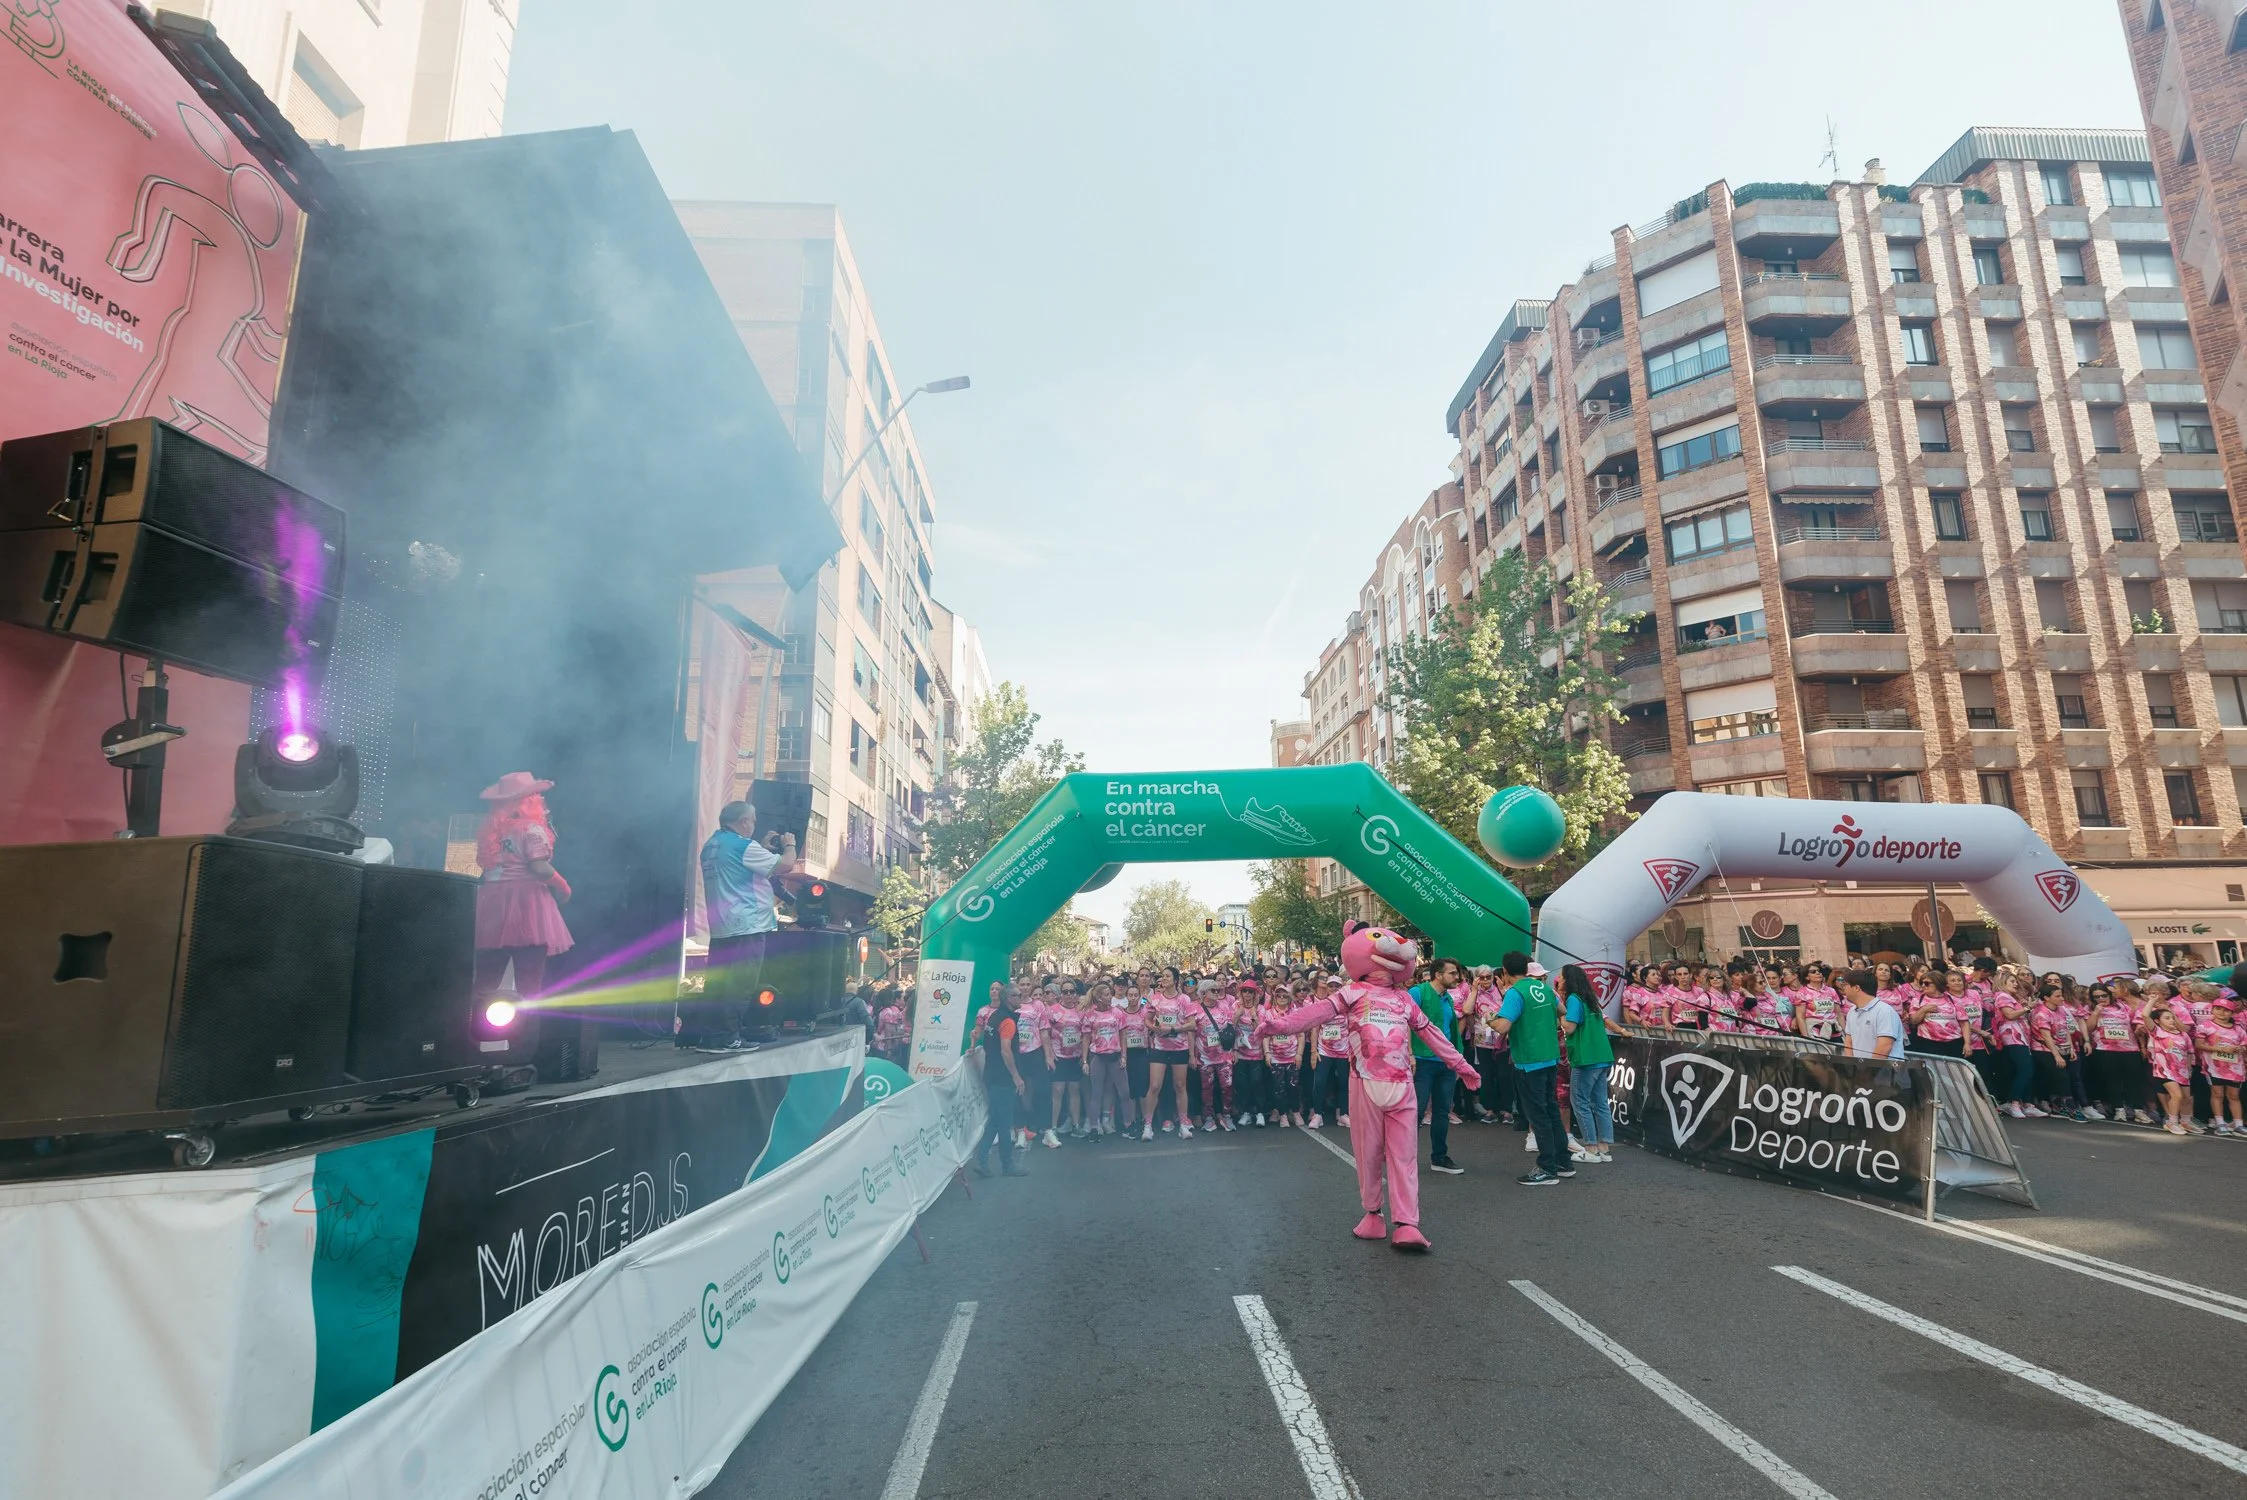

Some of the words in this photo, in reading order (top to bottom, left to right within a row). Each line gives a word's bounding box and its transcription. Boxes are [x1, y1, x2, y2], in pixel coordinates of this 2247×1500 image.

[66, 68, 104, 102] CONTRA
[108, 100, 118, 112] EL
[68, 59, 79, 72] LA
[82, 71, 108, 96] RIOJA
[0, 256, 144, 353] Investigación
[10, 239, 32, 266] la
[39, 257, 103, 306] Mujer
[106, 300, 140, 328] por
[8, 344, 22, 356] en
[24, 352, 38, 365] La
[40, 359, 68, 380] Rioja
[9, 332, 46, 356] contra
[48, 353, 58, 362] el
[60, 358, 96, 382] cáncer
[1104, 799, 1176, 816] contra
[1106, 782, 1132, 795] En
[1138, 780, 1220, 795] marcha
[986, 845, 1028, 882] asociación
[1028, 814, 1065, 847] española
[1106, 819, 1127, 837] el
[1131, 819, 1206, 837] cáncer
[1872, 836, 1962, 864] deporte
[992, 866, 1020, 890] contra
[1020, 858, 1028, 868] el
[1028, 836, 1056, 862] cáncer
[1000, 886, 1013, 899] en
[1011, 876, 1026, 888] La
[1022, 858, 1048, 879] Rioja
[1388, 859, 1400, 872] en
[1400, 870, 1412, 884] La
[1412, 880, 1435, 904] Rioja
[1396, 852, 1423, 878] contra
[1422, 875, 1432, 886] el
[1431, 884, 1460, 912] cáncer
[1404, 842, 1446, 884] asociación
[2148, 926, 2188, 934] LACOSTE
[932, 972, 940, 981] La
[942, 972, 966, 984] Rioja
[1738, 1074, 1906, 1132] Logroño
[1730, 1116, 1900, 1184] Deporte
[620, 1183, 632, 1250] THAN
[477, 1183, 620, 1332] MORE
[726, 1289, 744, 1311] contra
[726, 1318, 734, 1330] en
[734, 1308, 742, 1324] La
[742, 1298, 757, 1316] Rioja
[628, 1330, 669, 1374] asociación
[668, 1306, 697, 1339] española
[632, 1366, 656, 1396] contra
[658, 1353, 668, 1372] el
[666, 1336, 688, 1364] cáncer
[636, 1402, 647, 1420] en
[654, 1372, 678, 1398] Rioja
[534, 1403, 585, 1458] española
[530, 1448, 568, 1494] cáncer
